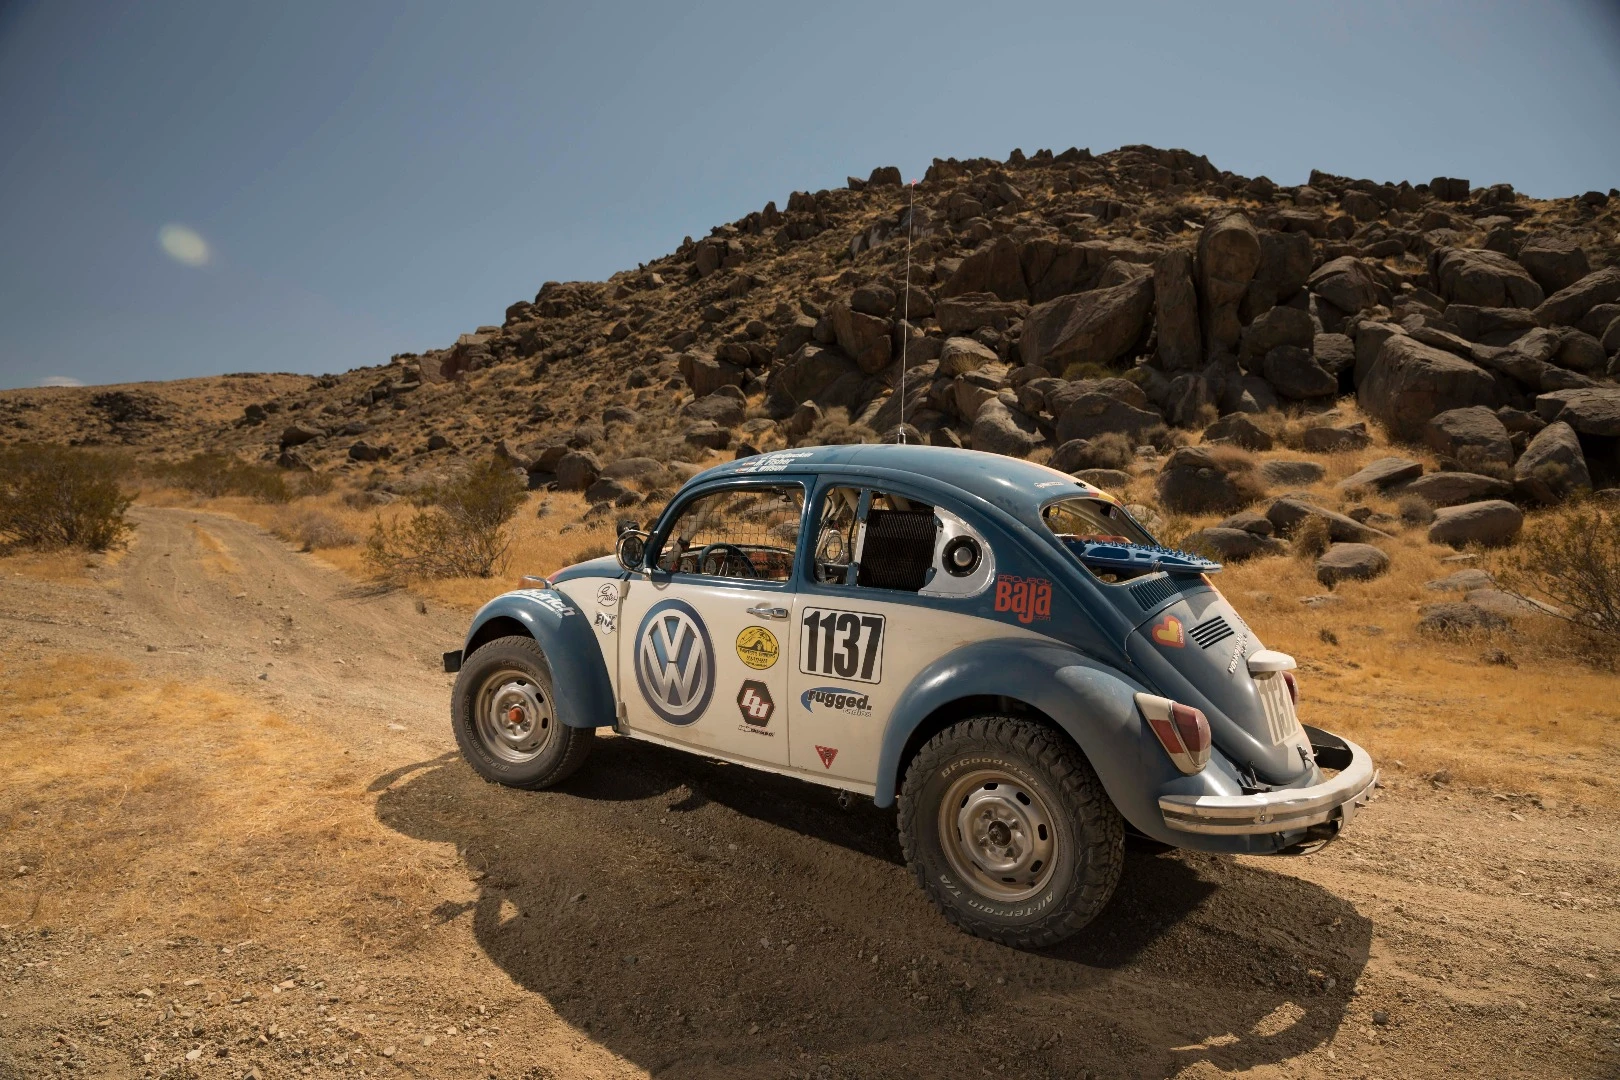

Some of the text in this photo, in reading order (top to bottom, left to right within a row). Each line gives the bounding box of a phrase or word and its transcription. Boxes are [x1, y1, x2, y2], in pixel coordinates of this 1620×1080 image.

[995, 580, 1052, 624] Baja
[640, 608, 708, 716] VW
[804, 610, 884, 681] 1137
[941, 757, 1039, 787] BFGoodrich
[940, 874, 963, 899] T/A
